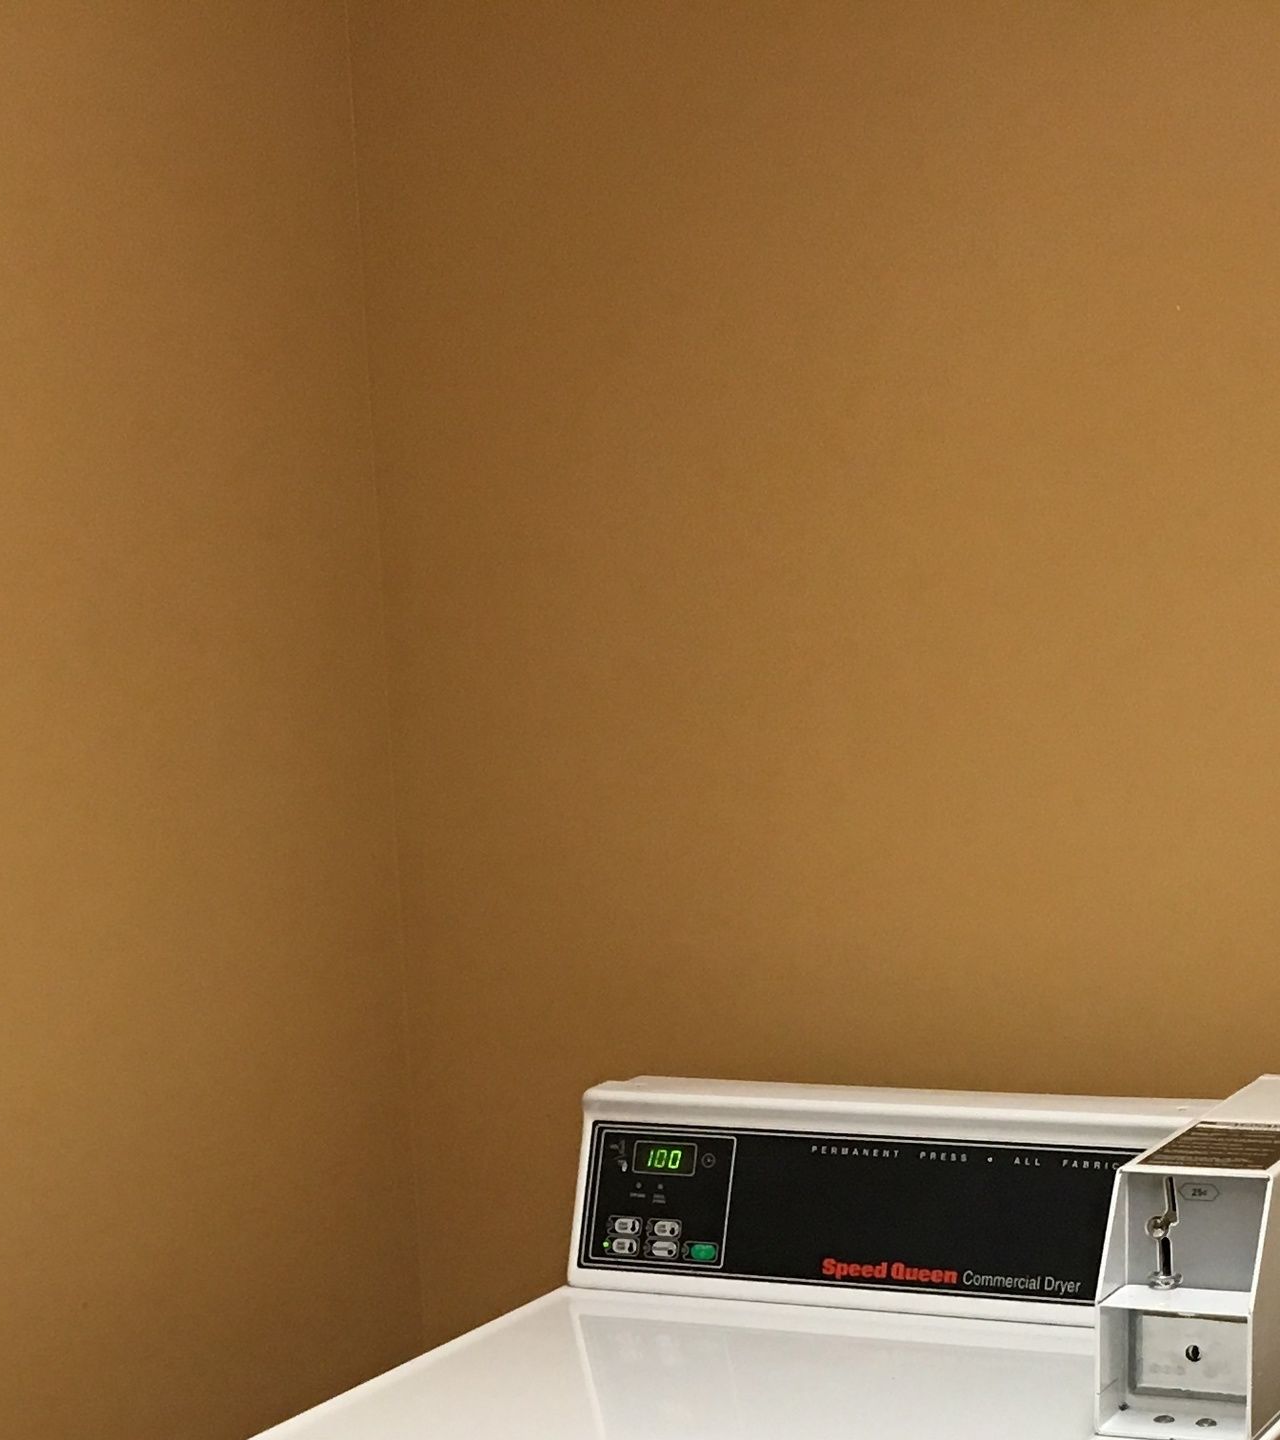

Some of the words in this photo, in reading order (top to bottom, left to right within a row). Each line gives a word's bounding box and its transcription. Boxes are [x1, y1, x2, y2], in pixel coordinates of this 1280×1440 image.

[647, 1149, 682, 1169] 100
[811, 1146, 900, 1159] PERMANENT
[919, 1151, 969, 1163] PRESS
[1014, 1156, 1041, 1167] ALL
[822, 1258, 887, 1280] Speed
[890, 1262, 958, 1284] Queen
[962, 1270, 1040, 1291] Commercial
[1044, 1276, 1081, 1294] Dryer
